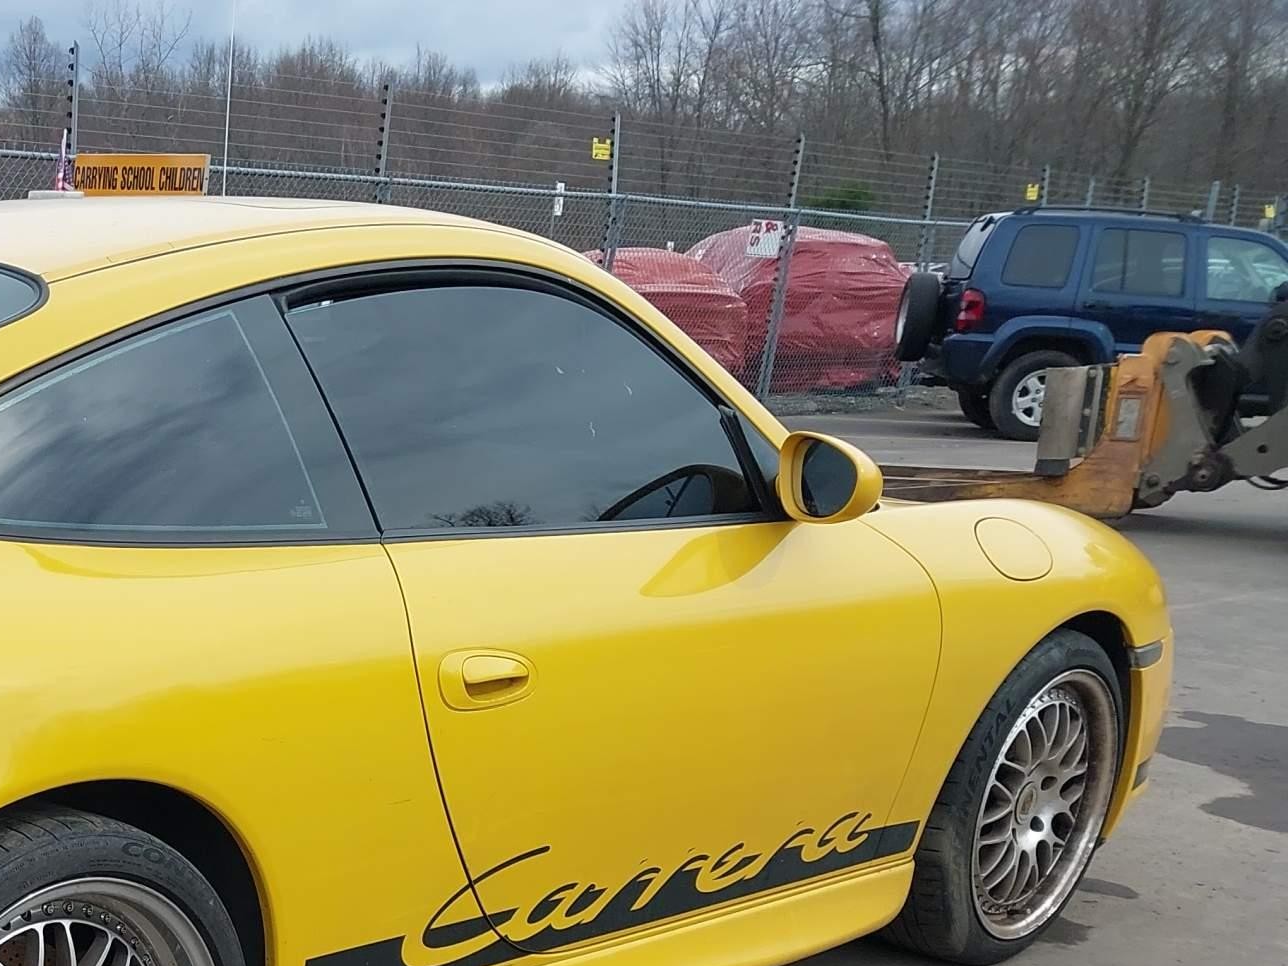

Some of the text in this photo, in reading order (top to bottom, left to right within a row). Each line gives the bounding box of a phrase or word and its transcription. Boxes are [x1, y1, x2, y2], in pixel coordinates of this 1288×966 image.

[74, 166, 205, 191] CARRYING SCHOOL CHILDREN
